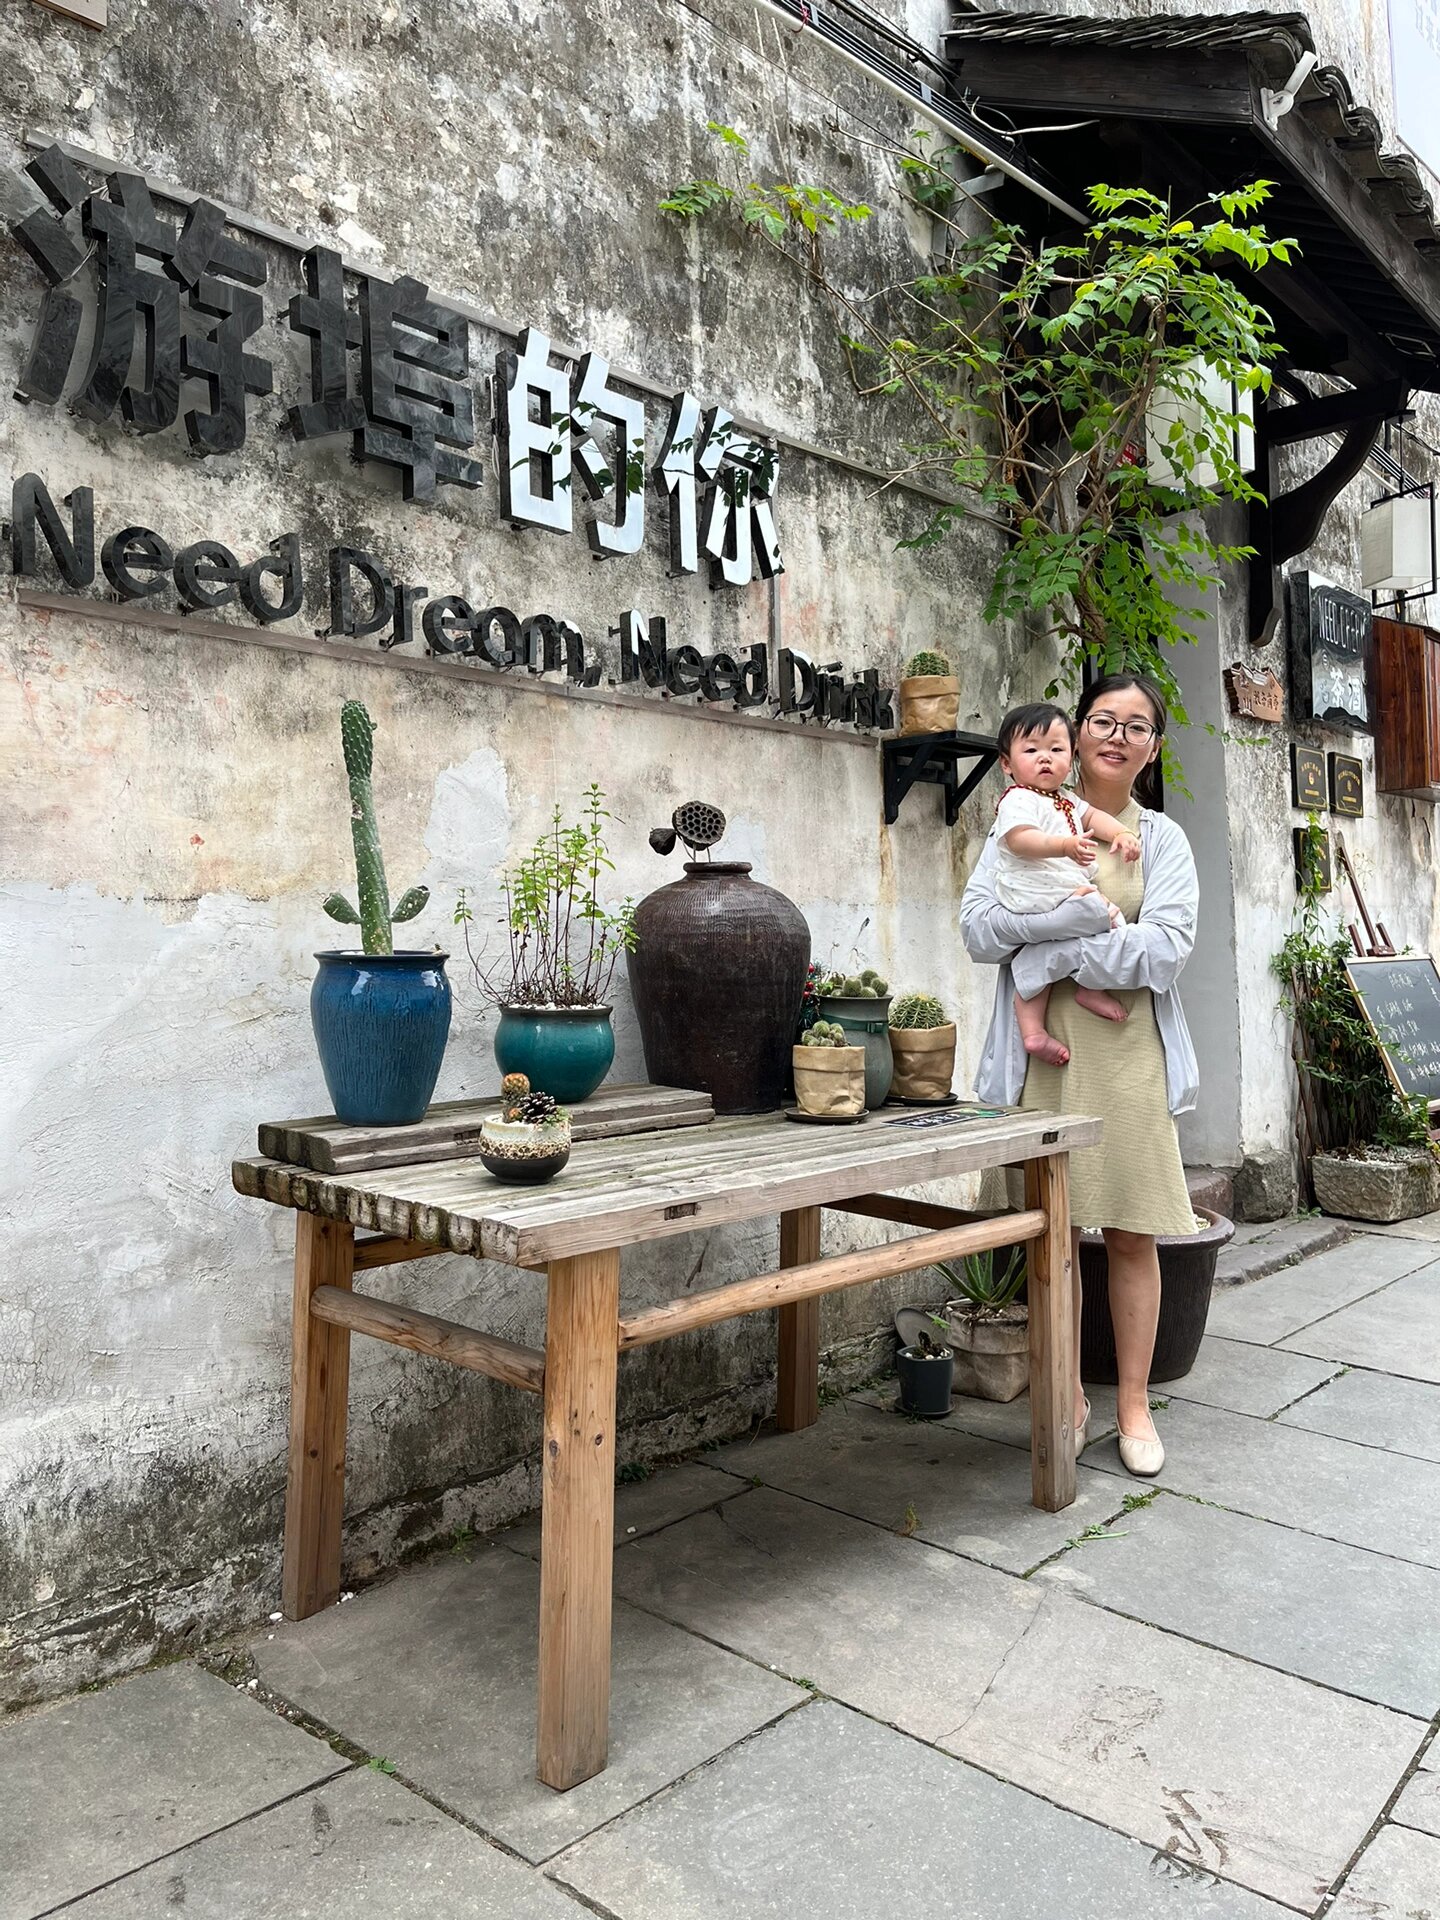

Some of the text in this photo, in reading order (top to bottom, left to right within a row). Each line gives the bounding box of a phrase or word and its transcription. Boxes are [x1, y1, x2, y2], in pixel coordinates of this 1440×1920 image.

[12, 472, 300, 624] Need
[620, 609, 768, 706] Need
[778, 648, 894, 729] Drink
